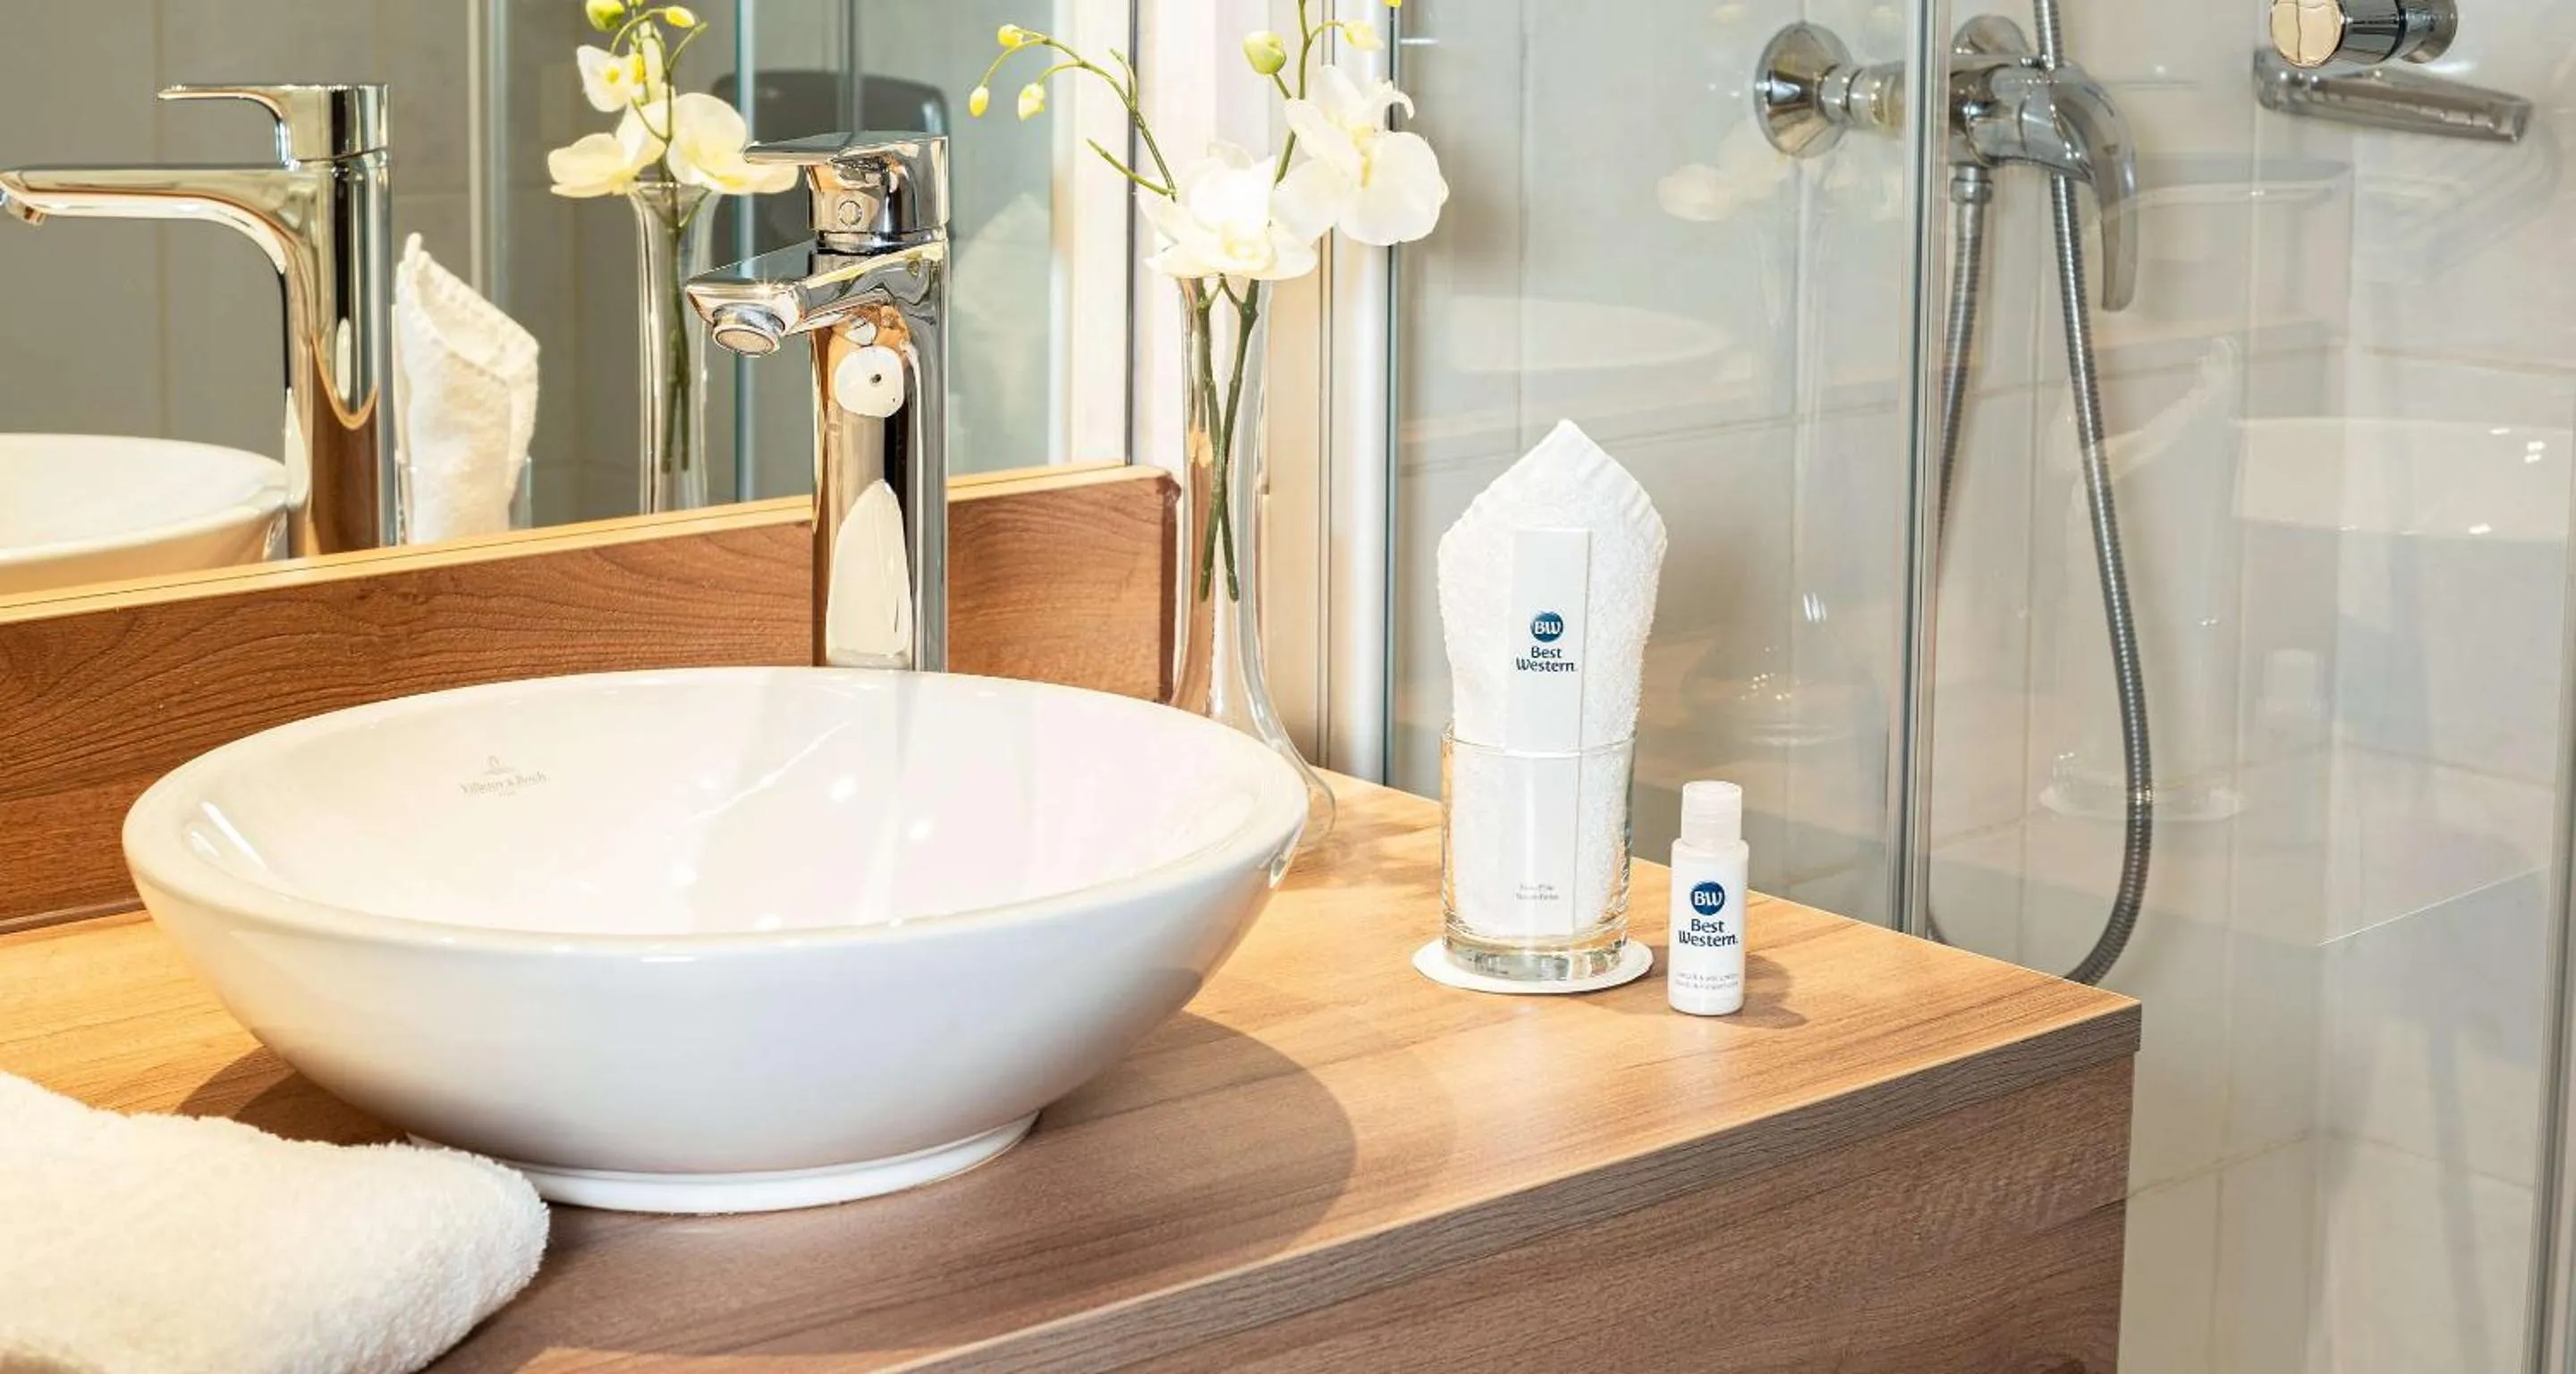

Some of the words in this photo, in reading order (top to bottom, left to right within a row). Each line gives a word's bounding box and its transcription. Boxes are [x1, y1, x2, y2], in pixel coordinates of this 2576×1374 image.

[1534, 621, 1562, 635] BW
[1530, 645, 1563, 658] Best
[1694, 890, 1723, 906] BW
[1690, 918, 1724, 933] Best
